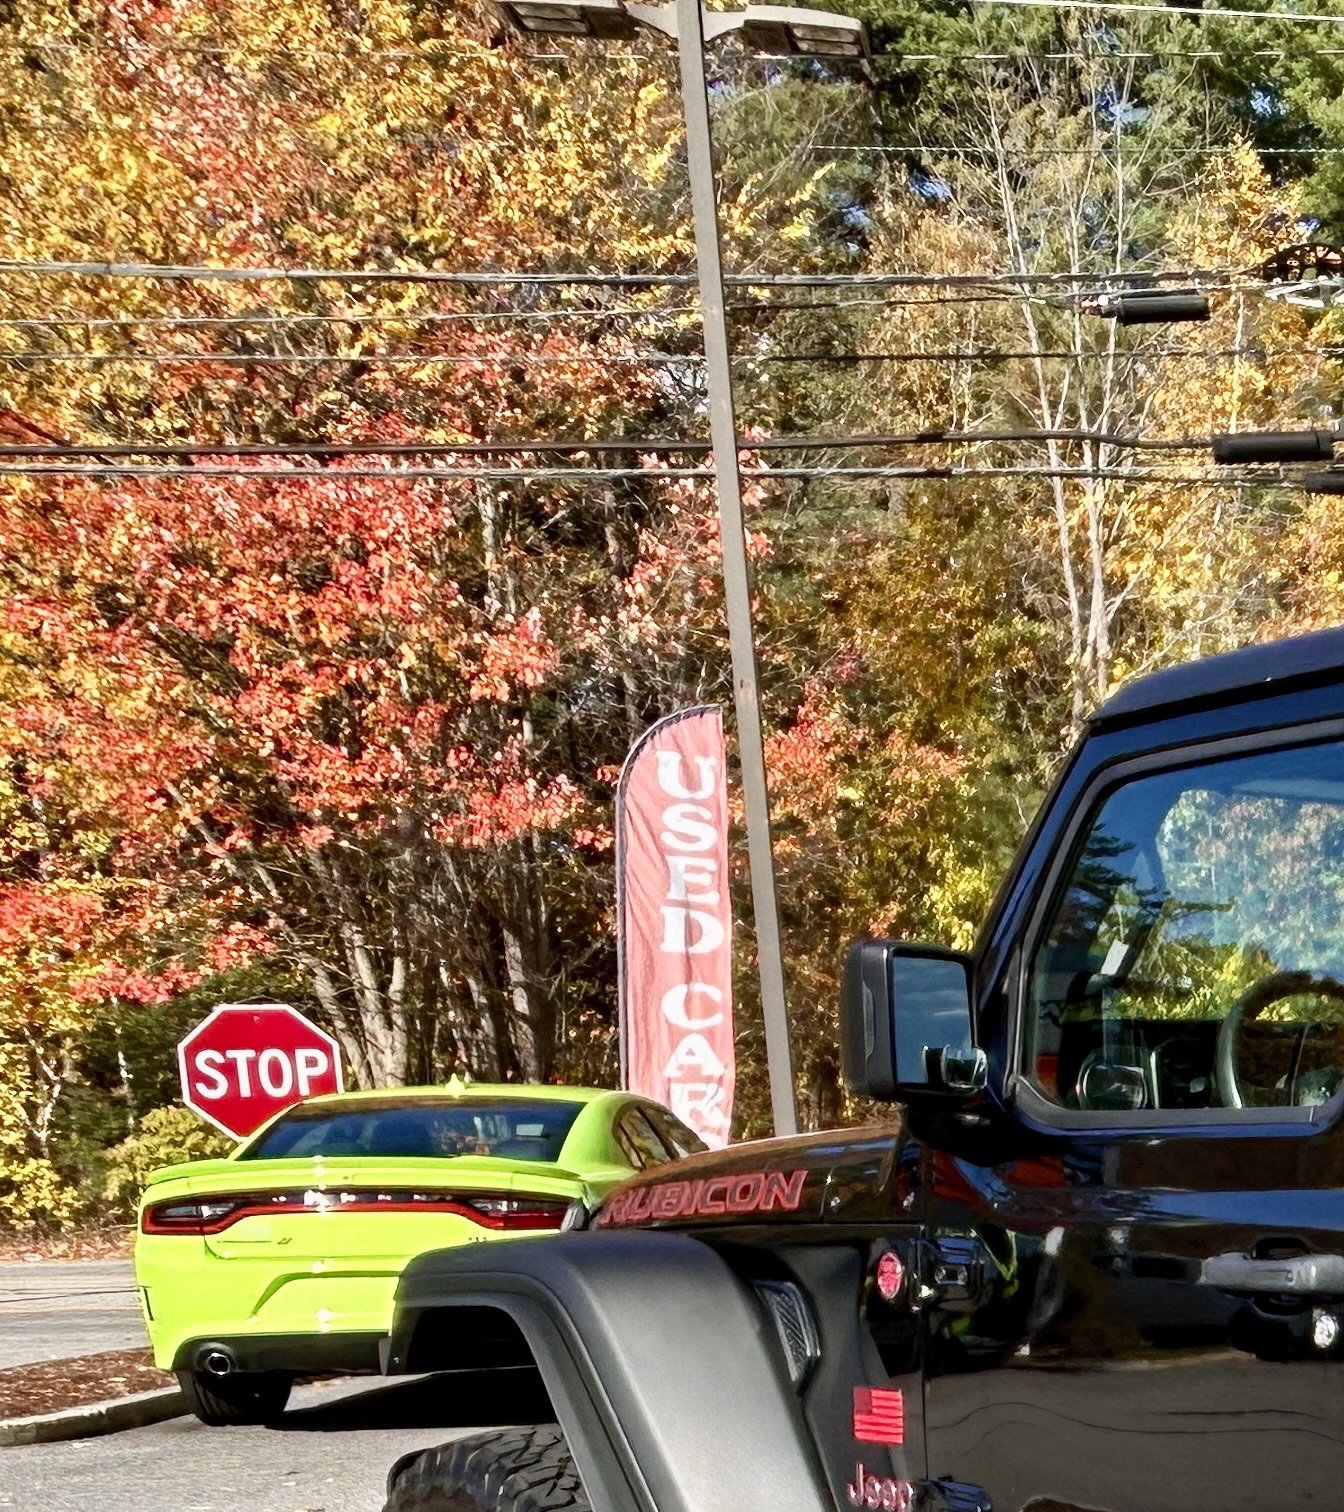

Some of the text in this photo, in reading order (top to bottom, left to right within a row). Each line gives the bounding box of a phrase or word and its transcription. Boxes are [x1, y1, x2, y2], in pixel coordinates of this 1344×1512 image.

[655, 750, 725, 953] USED
[194, 1047, 329, 1100] STOP
[598, 1168, 809, 1228] RUBICON
